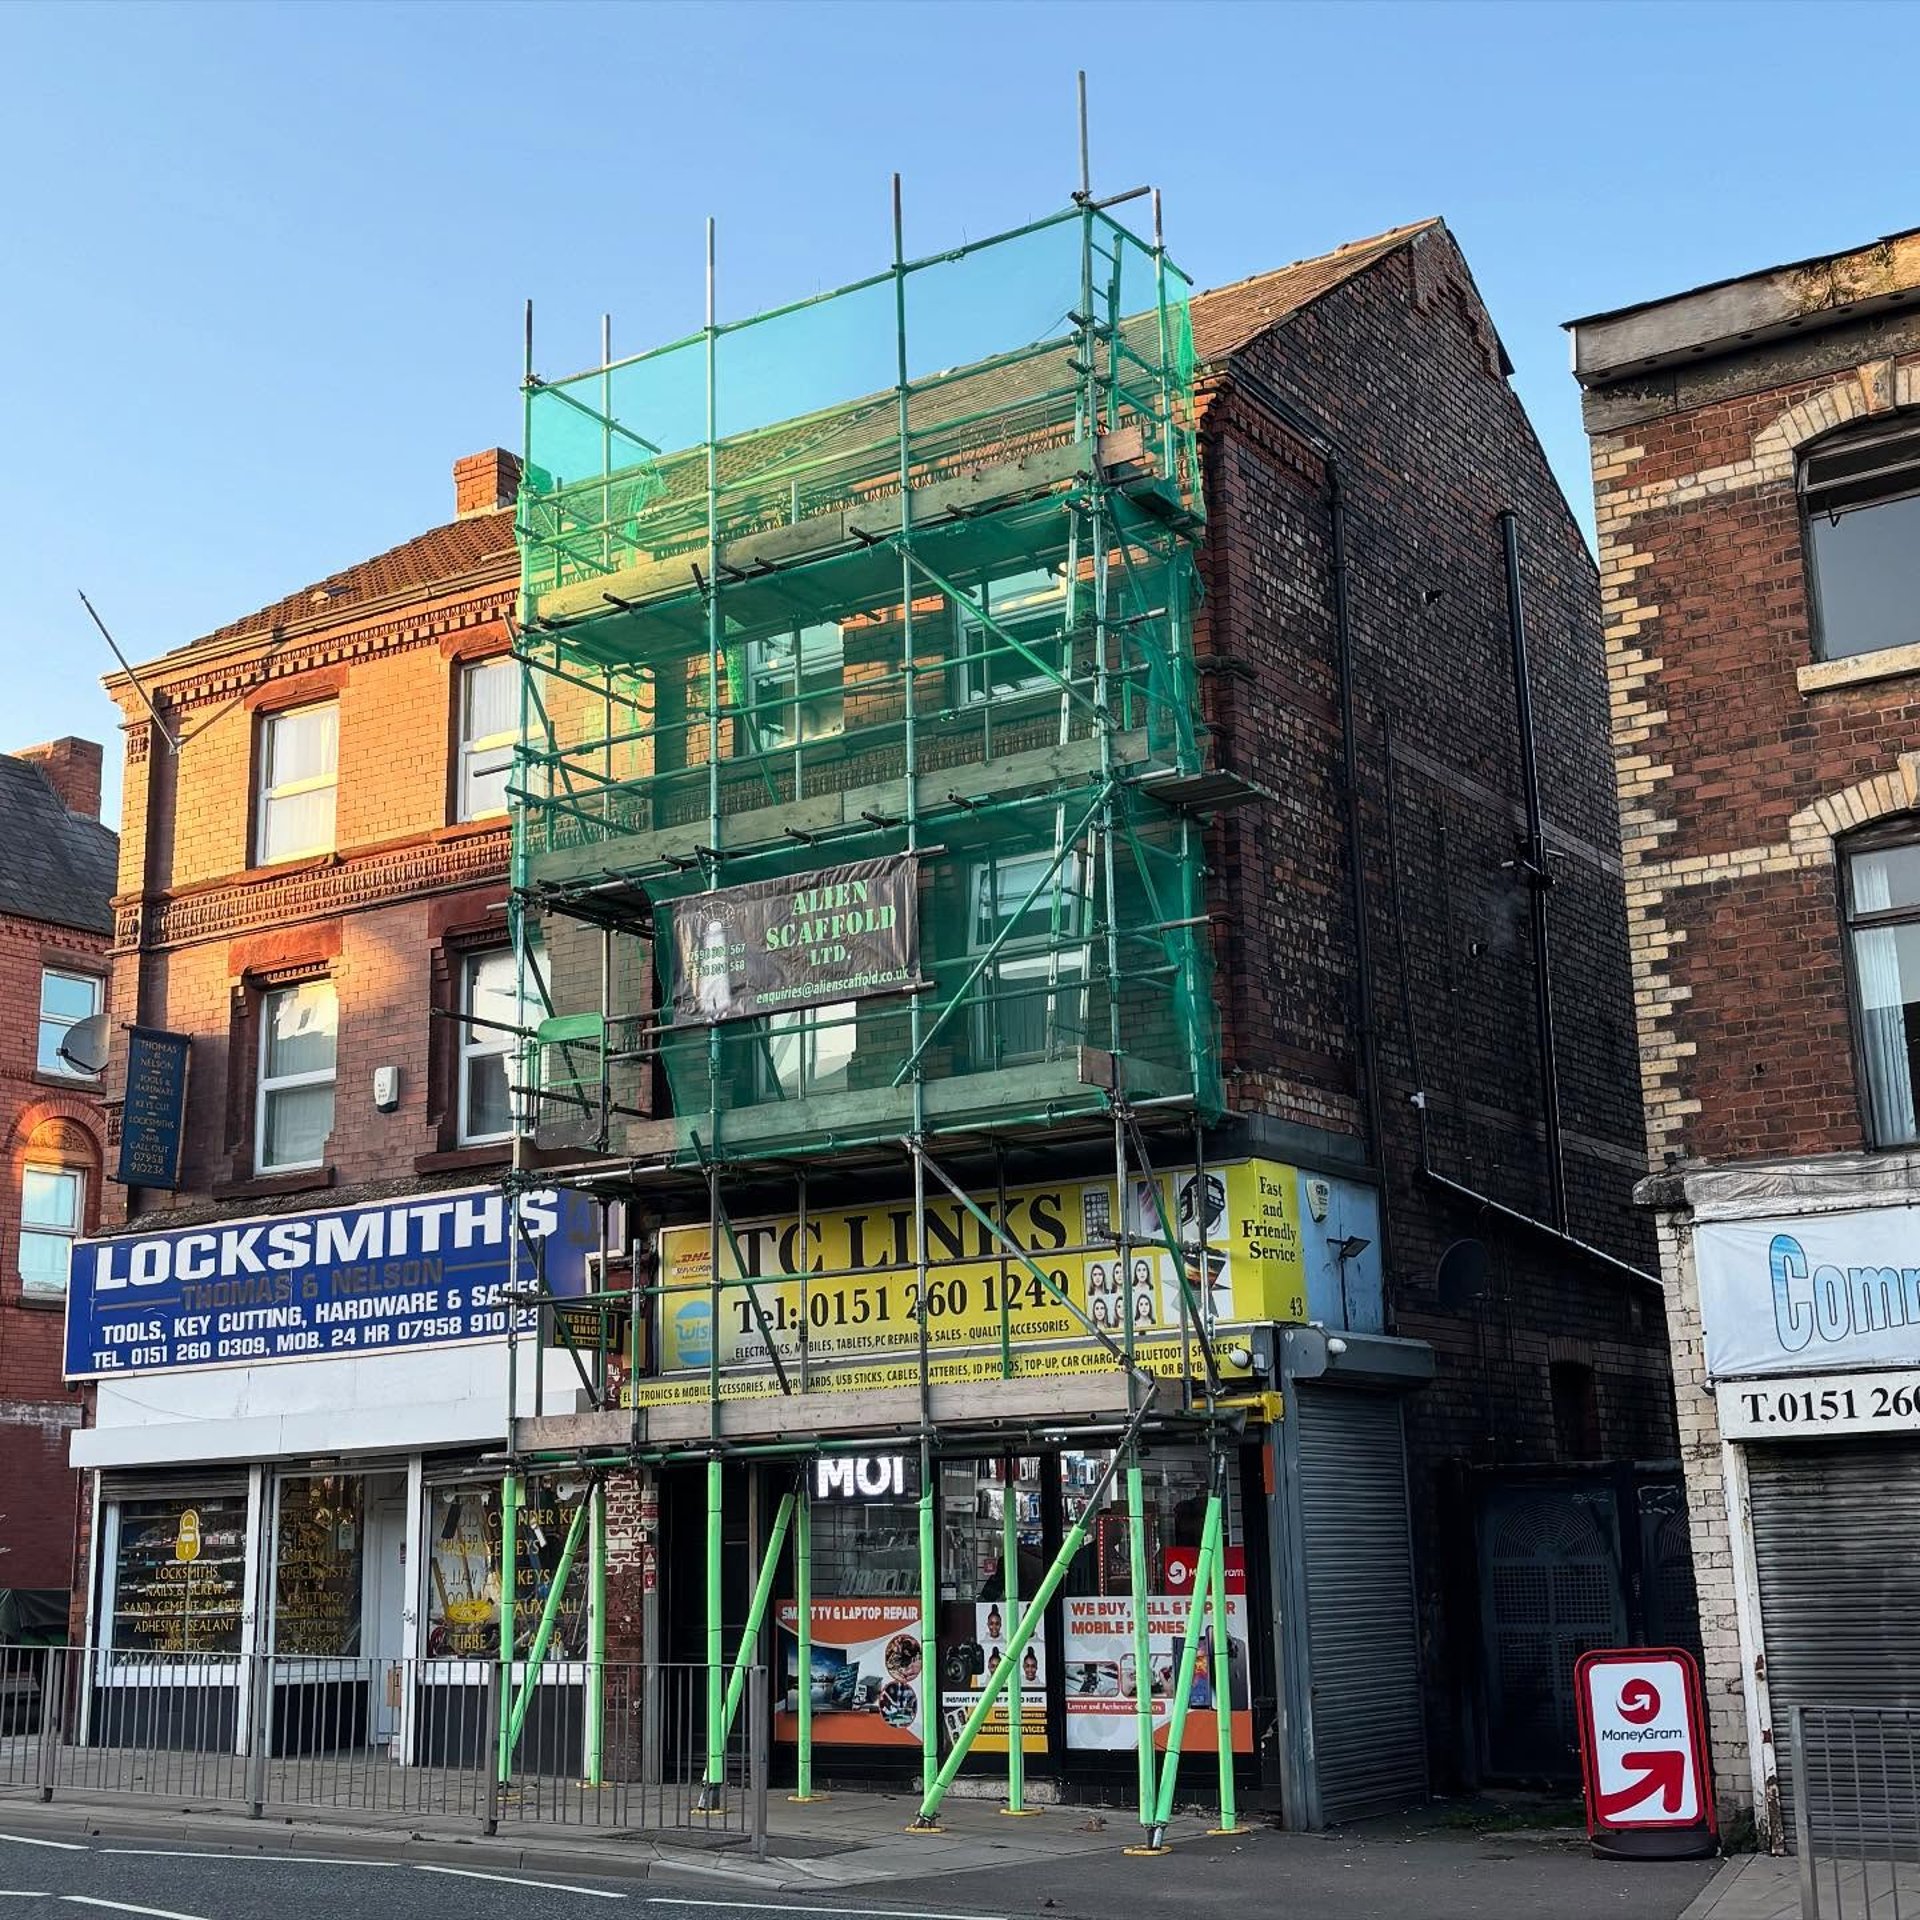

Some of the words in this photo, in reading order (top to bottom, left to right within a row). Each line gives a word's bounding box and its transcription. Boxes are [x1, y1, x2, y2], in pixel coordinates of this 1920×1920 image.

[792, 879, 869, 916] ALIEN
[766, 905, 897, 951] SCAFFOLD
[808, 944, 852, 967] LTD.
[756, 965, 909, 1006] enquiries@alienscaffold.co.uk
[140, 1039, 177, 1055] THOMAS
[140, 1057, 174, 1070] NELSON
[129, 1115, 175, 1130] LOCKSMITHS
[130, 1142, 150, 1152] CALL
[150, 1143, 169, 1154] OUT
[133, 1152, 164, 1164] 07958
[1259, 1176, 1283, 1197] Fast
[1263, 1200, 1284, 1219] and
[95, 1189, 558, 1291] LOCKSMITHS
[734, 1220, 823, 1278] TC
[844, 1193, 1067, 1270] LINKS
[1241, 1219, 1297, 1247] Friendly
[1249, 1240, 1296, 1263] Service
[181, 1274, 291, 1311] THOMAS
[331, 1258, 446, 1298] NELSON
[102, 1320, 166, 1344] TOOLS,
[174, 1314, 211, 1338] KEY
[218, 1305, 308, 1333] CUTTING,
[315, 1290, 439, 1324] HARDWARE
[447, 1288, 462, 1310] &
[471, 1279, 540, 1307] SAES
[733, 1296, 798, 1334] Tel:
[810, 1286, 891, 1328] 0151
[904, 1278, 968, 1320] 260
[982, 1269, 1069, 1312] 1249
[1289, 1296, 1304, 1317] 43
[131, 1345, 168, 1366] 0151
[176, 1341, 212, 1361] 260
[218, 1336, 270, 1357] 0309,
[276, 1331, 325, 1352] MOB.
[331, 1327, 357, 1347] 24
[364, 1323, 390, 1344] HR
[397, 1316, 462, 1340] 07958
[935, 1327, 961, 1342] SALES
[968, 1325, 1001, 1339] QUALIT
[1010, 1319, 1070, 1336] ACCESSORIES
[623, 1388, 673, 1402] ELTRONICS
[717, 1380, 767, 1395] CCESSORIES,
[836, 1373, 853, 1386] USB
[854, 1371, 883, 1386] STICKS,
[886, 1367, 921, 1382] CABLES,
[928, 1363, 971, 1379] ATTERIES,
[973, 1361, 983, 1375] ID
[1024, 1357, 1060, 1371] TOP-UP,
[1062, 1355, 1079, 1368] CAR
[1135, 1347, 1182, 1362] BLUETOOT
[1161, 1362, 1175, 1375] OR
[1741, 1388, 1860, 1424] T.0151
[155, 1566, 219, 1580] LOCKSMITHS
[518, 1568, 550, 1585] KEYS
[842, 1606, 882, 1620] LAPTOP
[883, 1606, 919, 1620] REPAIR
[1071, 1602, 1095, 1617] WE
[1099, 1602, 1132, 1618] BUY,
[188, 1618, 236, 1632] SEALANT
[1071, 1620, 1125, 1635] MOBILE
[1127, 1620, 1189, 1635] PONES.
